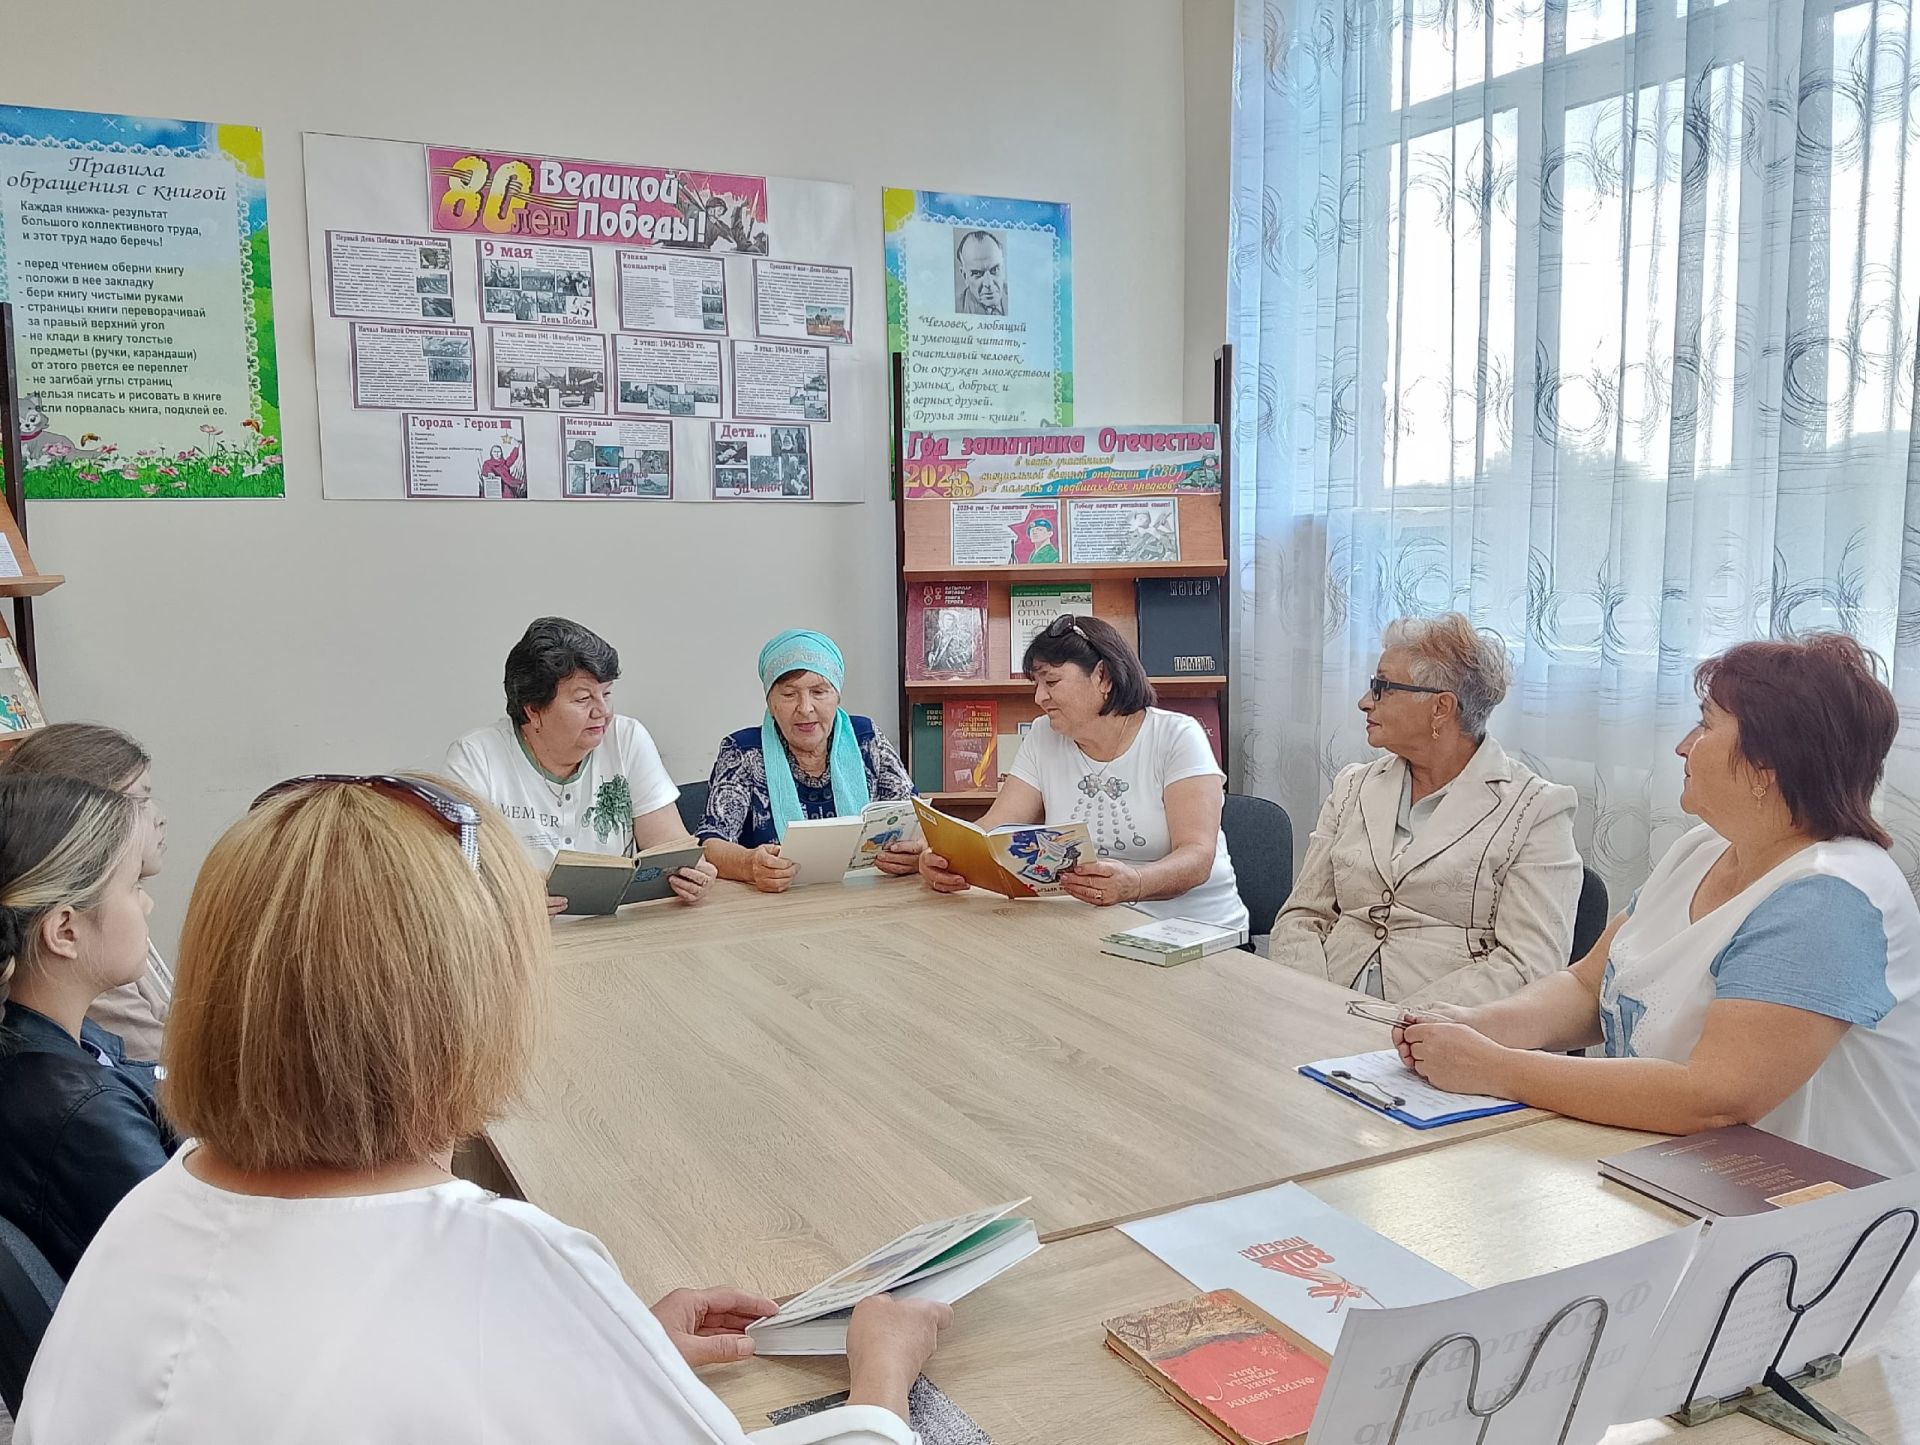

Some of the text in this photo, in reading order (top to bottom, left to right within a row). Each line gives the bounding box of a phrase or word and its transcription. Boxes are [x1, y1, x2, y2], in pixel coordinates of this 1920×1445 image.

[68, 156, 165, 178] Правила
[7, 171, 228, 201] обращения с книгой
[438, 155, 680, 234] 80 Великой
[21, 201, 168, 220] Каждая книжка- результат
[21, 216, 202, 238] большого коллективного труда,
[512, 202, 707, 243] лет Победы!
[22, 233, 163, 247] и этот труд надо беречь!
[484, 241, 494, 256] 9
[500, 247, 534, 259] мая
[24, 260, 185, 277] перед чтением оберни книгу
[26, 275, 154, 289] положи в нее закладку
[26, 288, 184, 304] бери книгу чистыми руками
[28, 303, 206, 318] страницы книги переворачивай
[28, 318, 165, 331] за правый верхний угол
[541, 315, 593, 326] День Победы
[977, 320, 1026, 332] любящий
[29, 333, 43, 341] не
[46, 333, 80, 343] клади
[93, 335, 123, 345] книгу
[126, 336, 173, 345] толстые
[921, 334, 974, 346] умеющий
[30, 347, 197, 361] предметы (ручки, карандаши)
[912, 350, 978, 360] счастливый
[31, 362, 45, 370] от
[47, 362, 77, 371] этого
[81, 363, 119, 373] рвется
[138, 364, 188, 374] переплет
[912, 363, 1051, 379] Он окружен множеством
[33, 374, 173, 388] не загибай углы страниц
[958, 380, 999, 393] добрых
[34, 391, 222, 403] нельзя писать и рисовать в книге
[913, 395, 993, 408] верных друзей.
[34, 405, 228, 417] если порвалась книга, подклей ее.
[913, 411, 954, 423] Друзья
[957, 414, 979, 422] эти
[411, 416, 498, 431] Города Герои
[566, 418, 613, 428] Мемориалы
[908, 427, 1215, 458] Год защитника Отечества
[1017, 599, 1047, 608] ДОЛГ
[1237, 1235, 1309, 1259] ПОБЕДА!
[1226, 1376, 1315, 1409] ФАТИХ КӘРИМ
